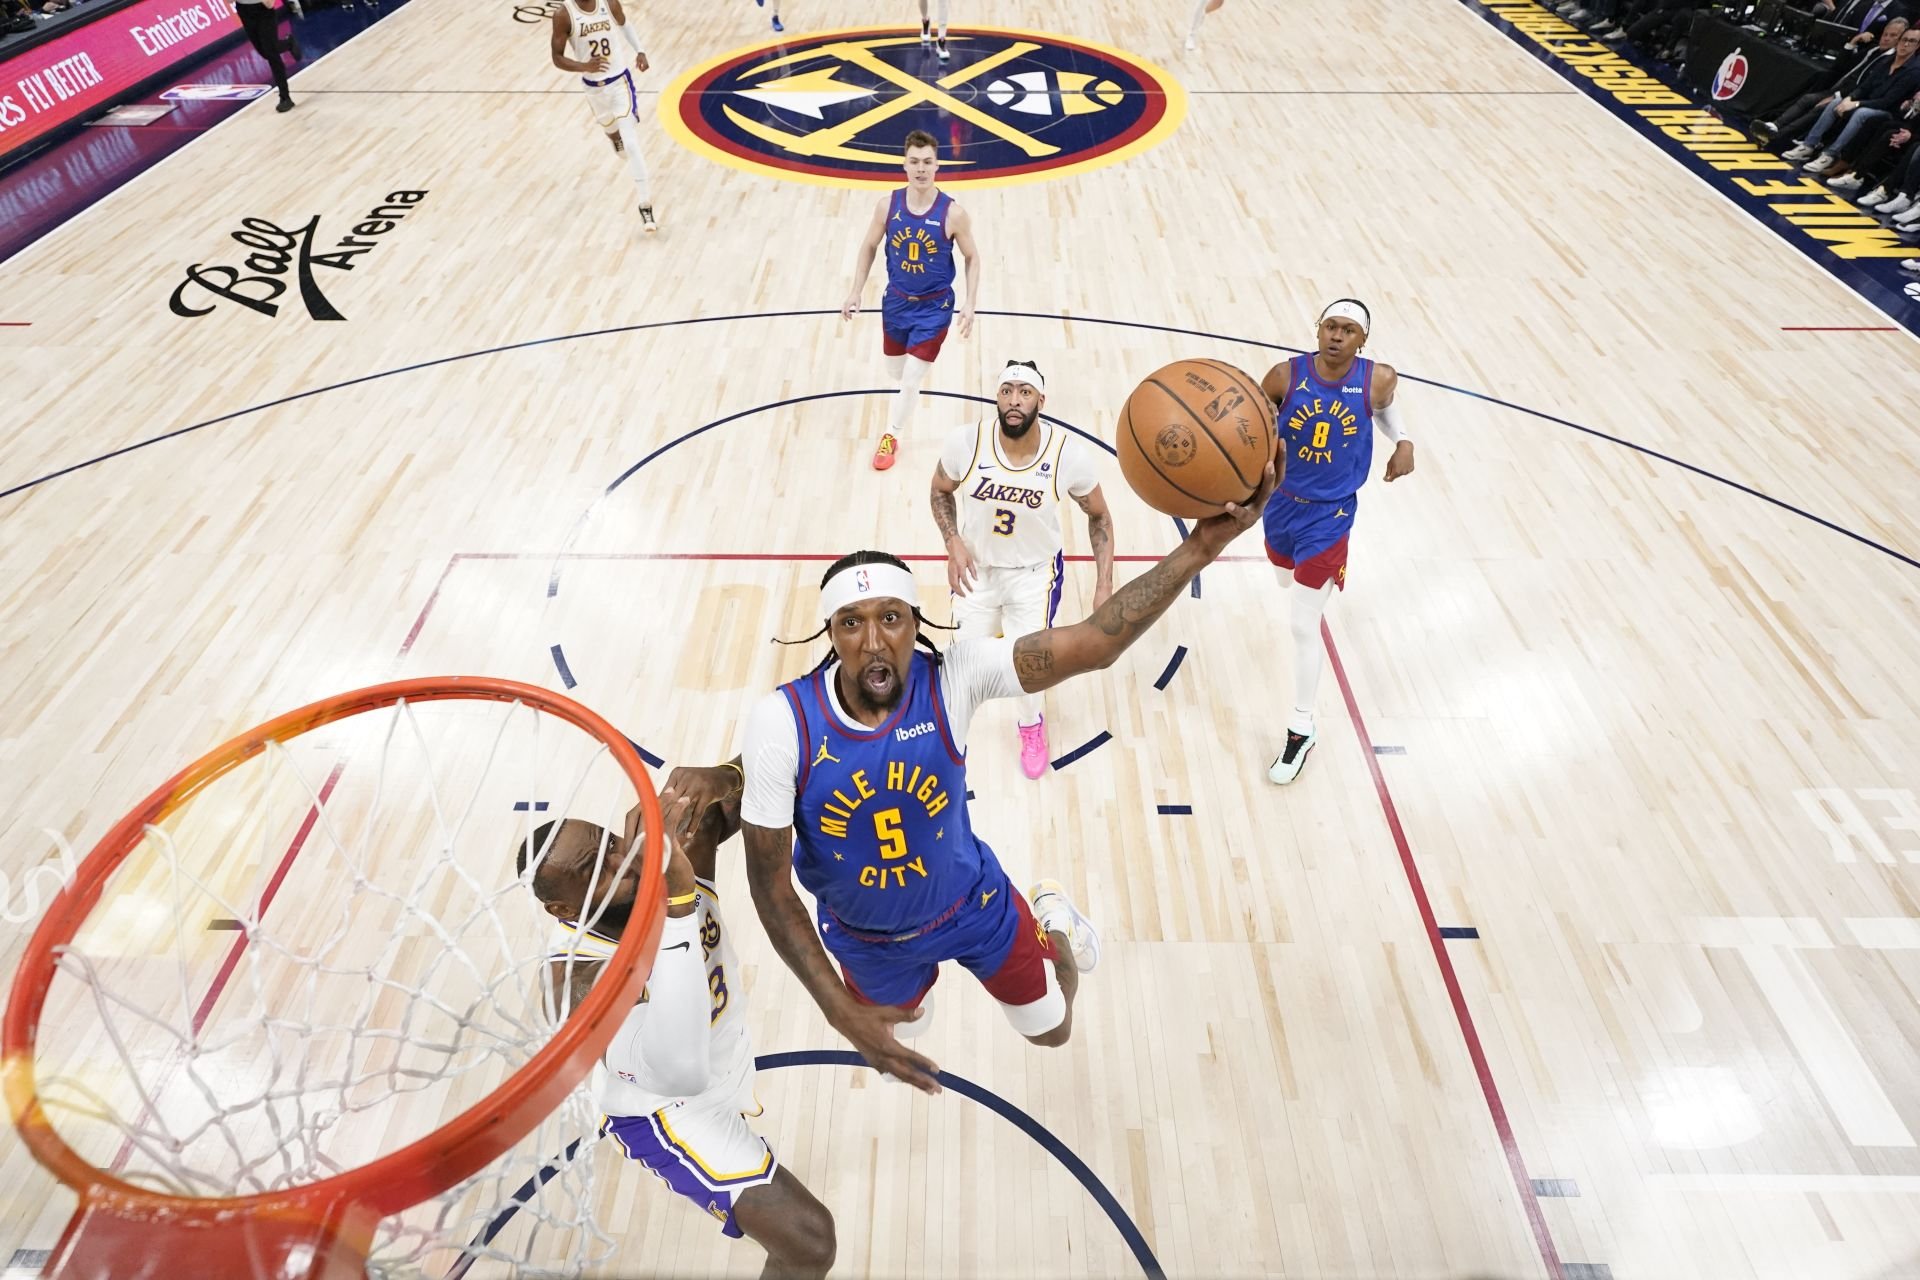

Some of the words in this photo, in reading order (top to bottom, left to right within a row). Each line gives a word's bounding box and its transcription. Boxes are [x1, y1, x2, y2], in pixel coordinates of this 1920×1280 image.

[129, 2, 211, 57] Emirates
[579, 21, 611, 37] LAKERS
[588, 38, 611, 57] 28
[18, 74, 59, 113] FLY
[43, 51, 104, 101] BETTER
[1636, 109, 1794, 170] HIGH
[309, 190, 429, 271] Arena
[1731, 177, 1920, 259] MILE
[891, 226, 913, 249] MILE
[915, 228, 938, 254] HIGH
[908, 241, 920, 261] 0
[169, 215, 347, 320] Ball
[900, 260, 925, 274] CITY
[1341, 385, 1363, 394] ibotta
[1288, 398, 1324, 431] MILE
[1328, 399, 1358, 436] HIGH
[1312, 421, 1330, 448] 8
[1298, 445, 1332, 464] CITY
[969, 476, 1044, 509] LAKERS
[992, 508, 1016, 538] 3
[895, 721, 936, 742] ibotta
[820, 769, 877, 838] MILE
[887, 761, 949, 819] HIGH
[873, 807, 908, 860] 5
[859, 856, 928, 889] CITY
[707, 963, 730, 1028] 3
